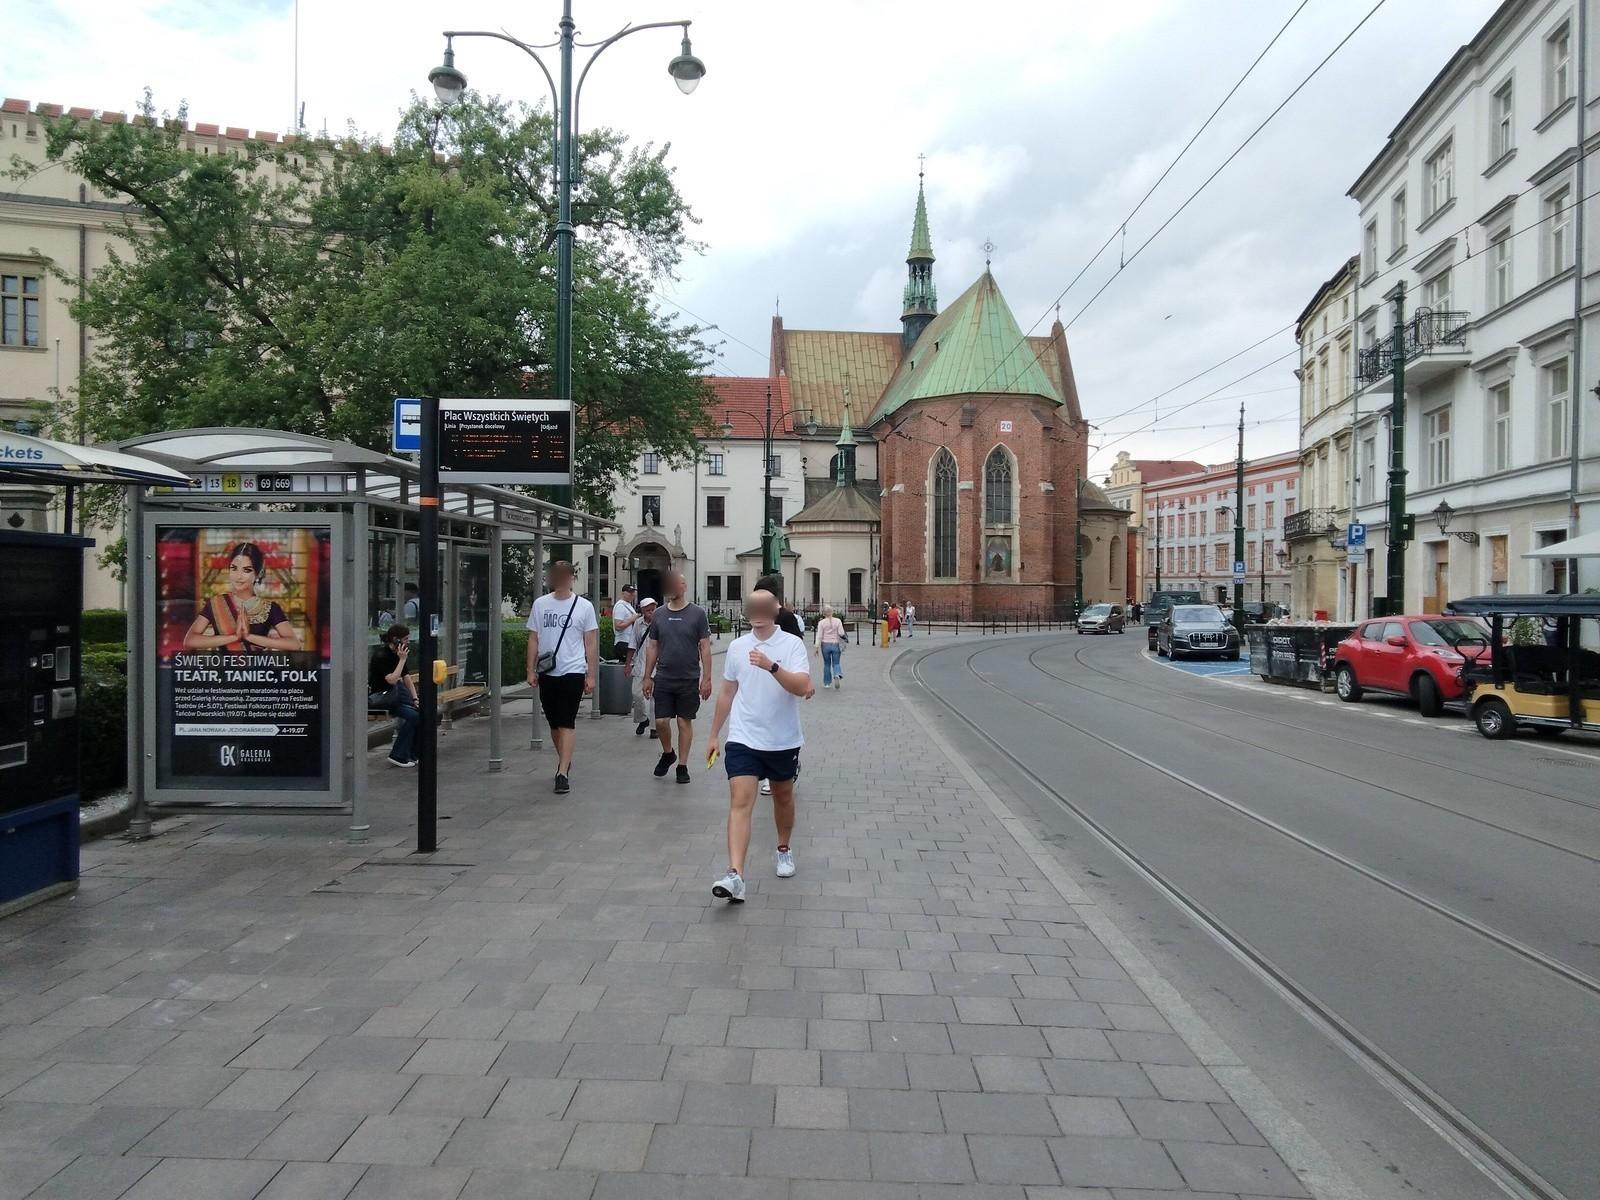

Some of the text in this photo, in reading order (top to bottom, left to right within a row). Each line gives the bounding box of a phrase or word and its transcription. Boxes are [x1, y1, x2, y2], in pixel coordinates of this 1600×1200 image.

[444, 411, 550, 423] Plac Wszystkich Świętych
[1001, 422, 1011, 430] 20
[210, 479, 220, 489] 13
[227, 479, 237, 488] 18
[243, 479, 254, 488] 66
[260, 479, 271, 488] 69
[275, 479, 290, 488] 669
[1351, 525, 1363, 540] P
[1236, 562, 1244, 571] P
[175, 652, 290, 669] ŚWIĘTO FESTIWALI:
[175, 670, 318, 683] TEATR, TANIEC, FOLK
[240, 749, 271, 758] GALERIA
